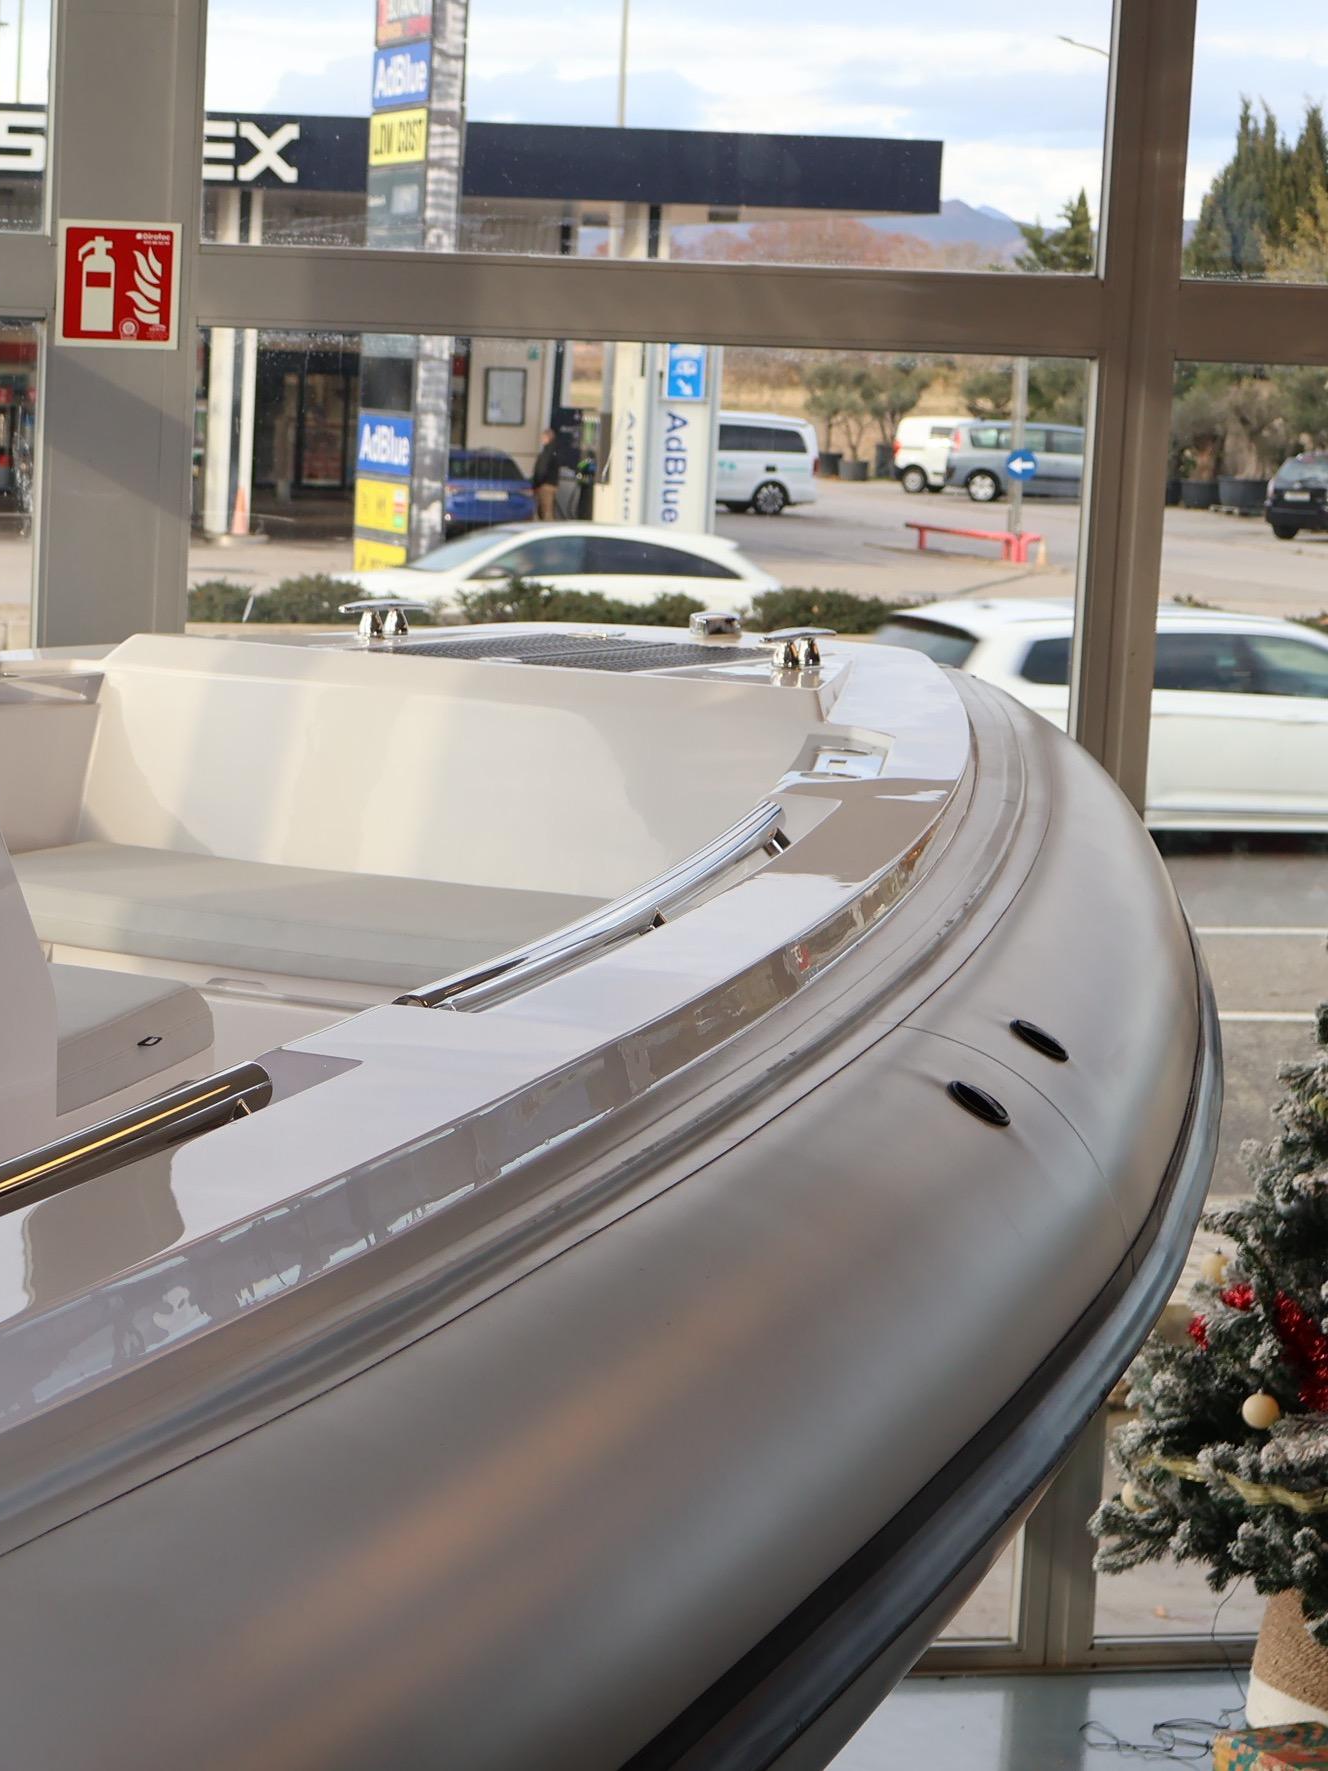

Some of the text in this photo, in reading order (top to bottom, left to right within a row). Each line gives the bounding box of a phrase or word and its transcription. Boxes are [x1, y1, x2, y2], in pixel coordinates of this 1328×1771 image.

[374, 53, 428, 99] AdBlue
[374, 118, 424, 155] LOW COST
[359, 423, 410, 467] AdBlue
[662, 411, 688, 523] AdBlue
